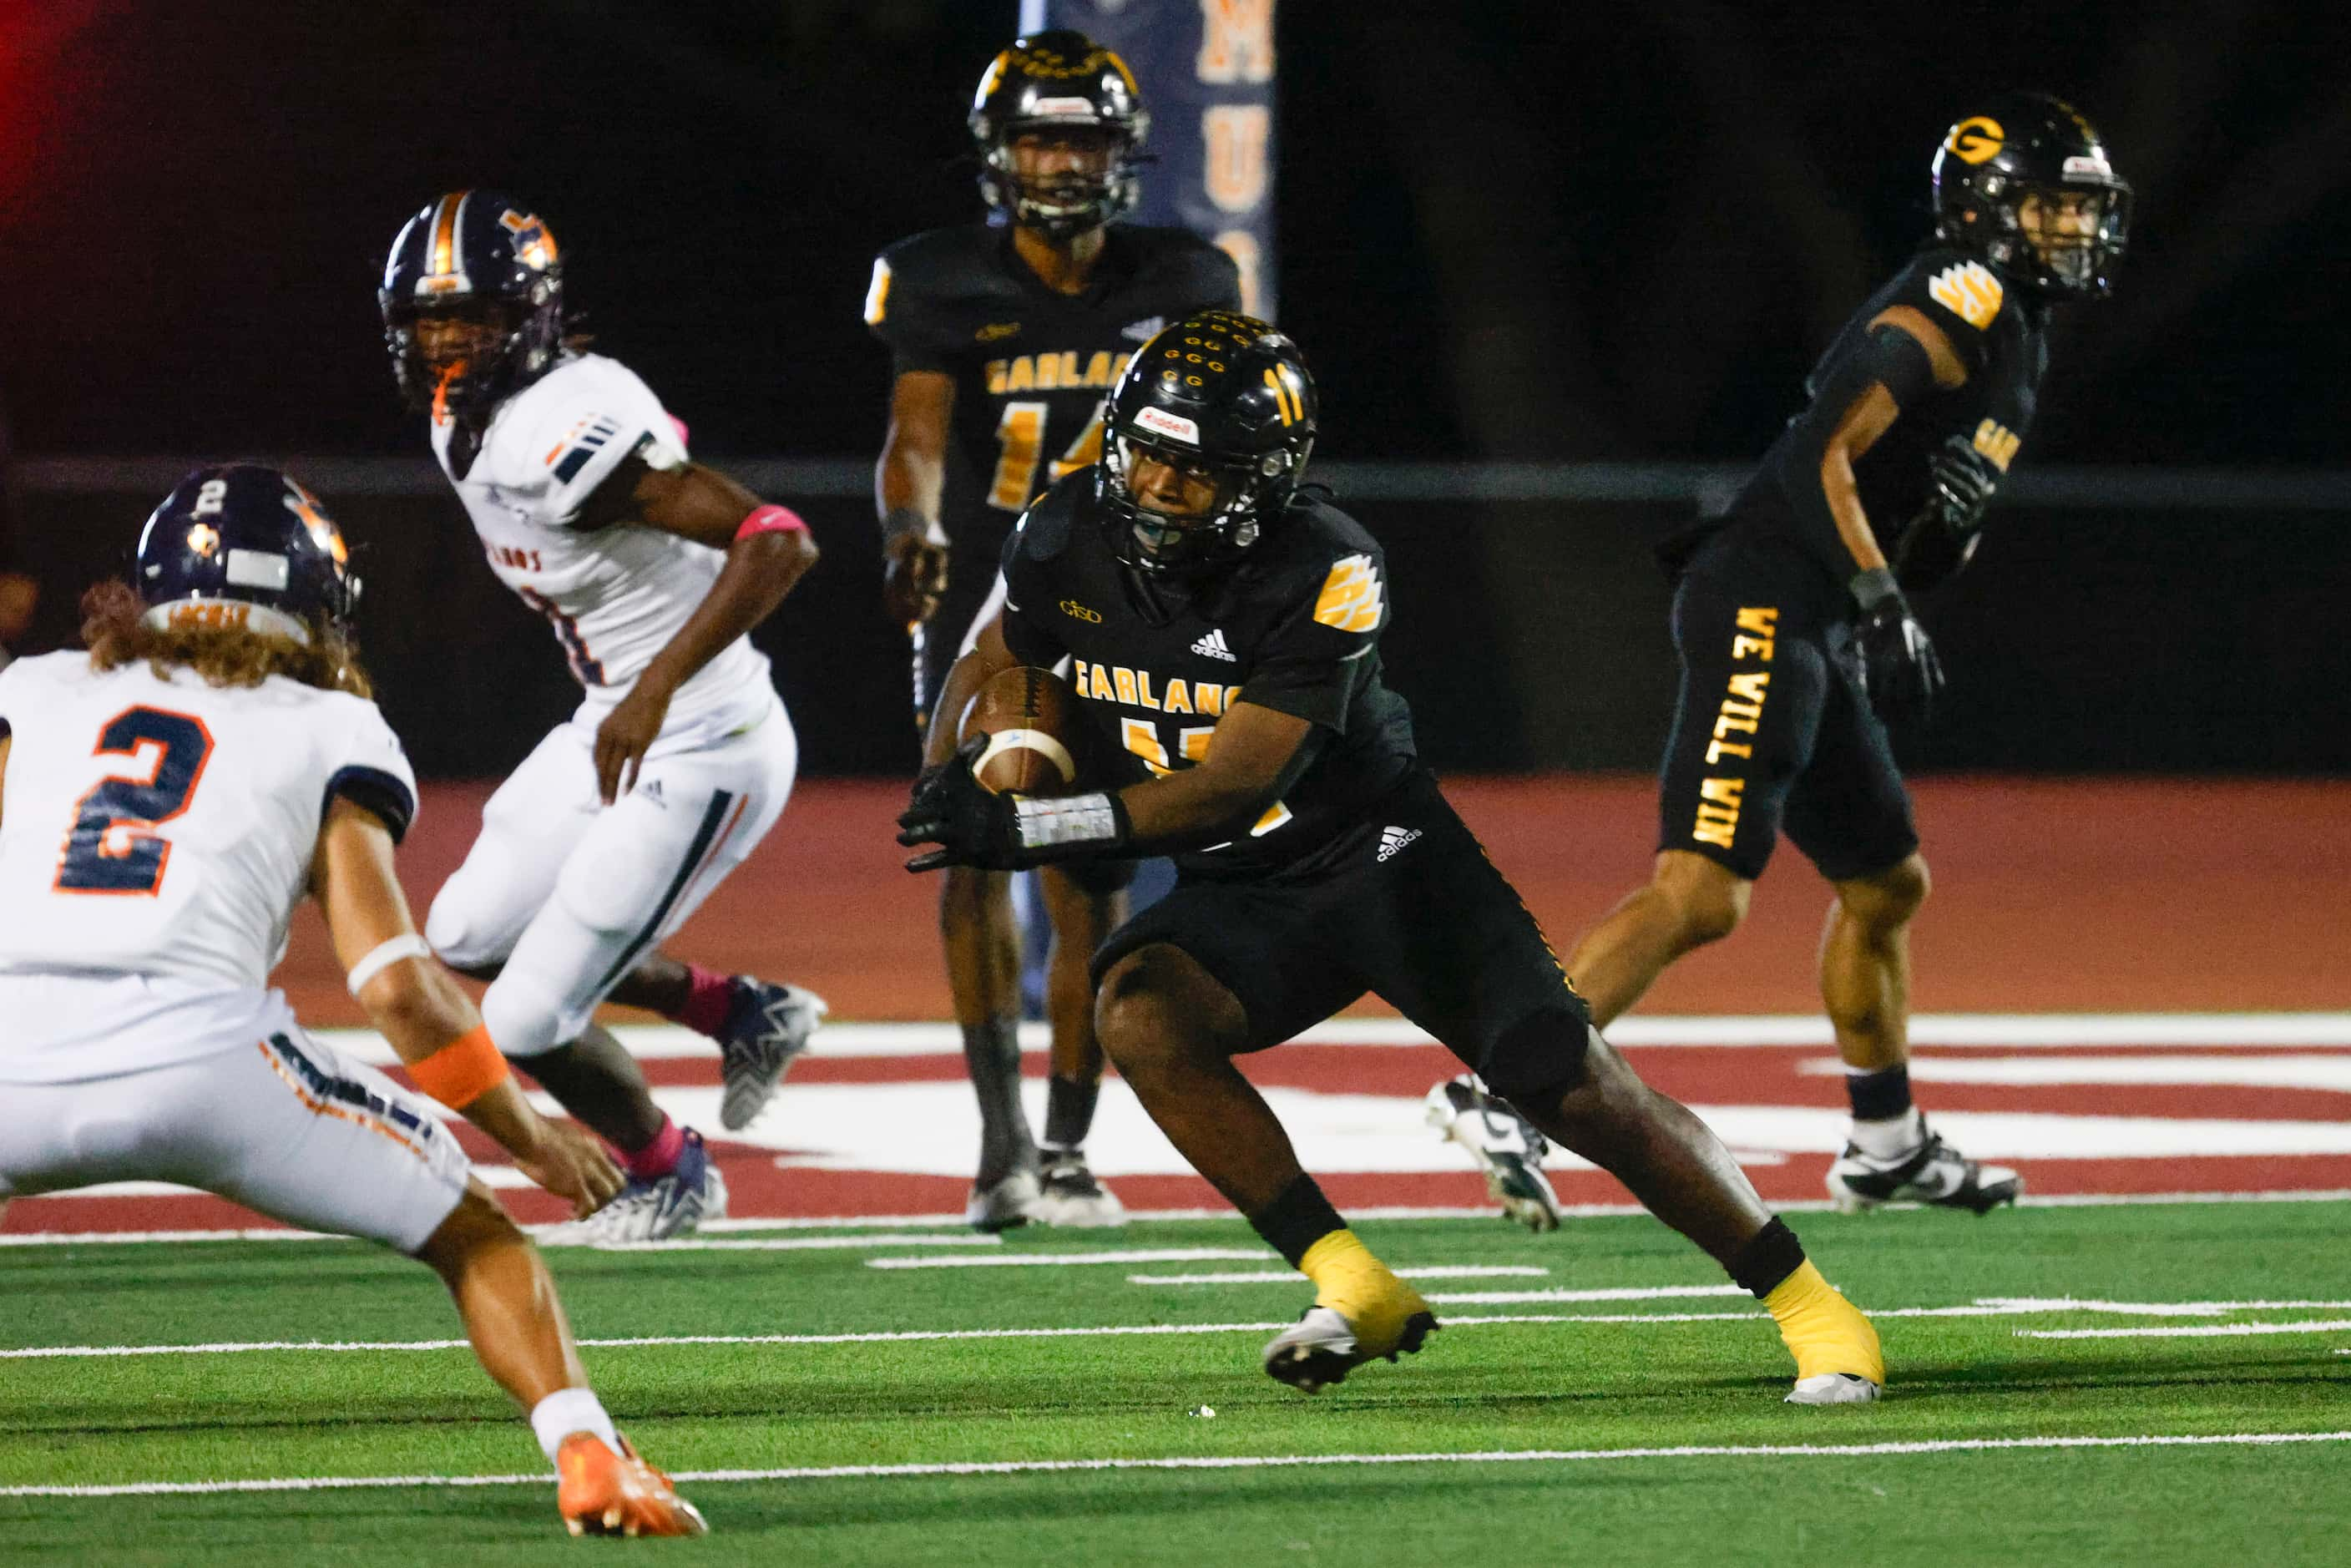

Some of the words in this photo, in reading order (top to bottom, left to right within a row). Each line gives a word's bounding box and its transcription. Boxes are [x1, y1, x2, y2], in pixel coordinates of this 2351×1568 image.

[1951, 116, 2004, 164] G
[193, 479, 227, 518] 2
[1732, 607, 1779, 661] WE
[1705, 671, 1771, 764] WILL
[53, 705, 215, 898] 2
[1692, 777, 1746, 850] WIN
[1376, 828, 1423, 863] adidas
